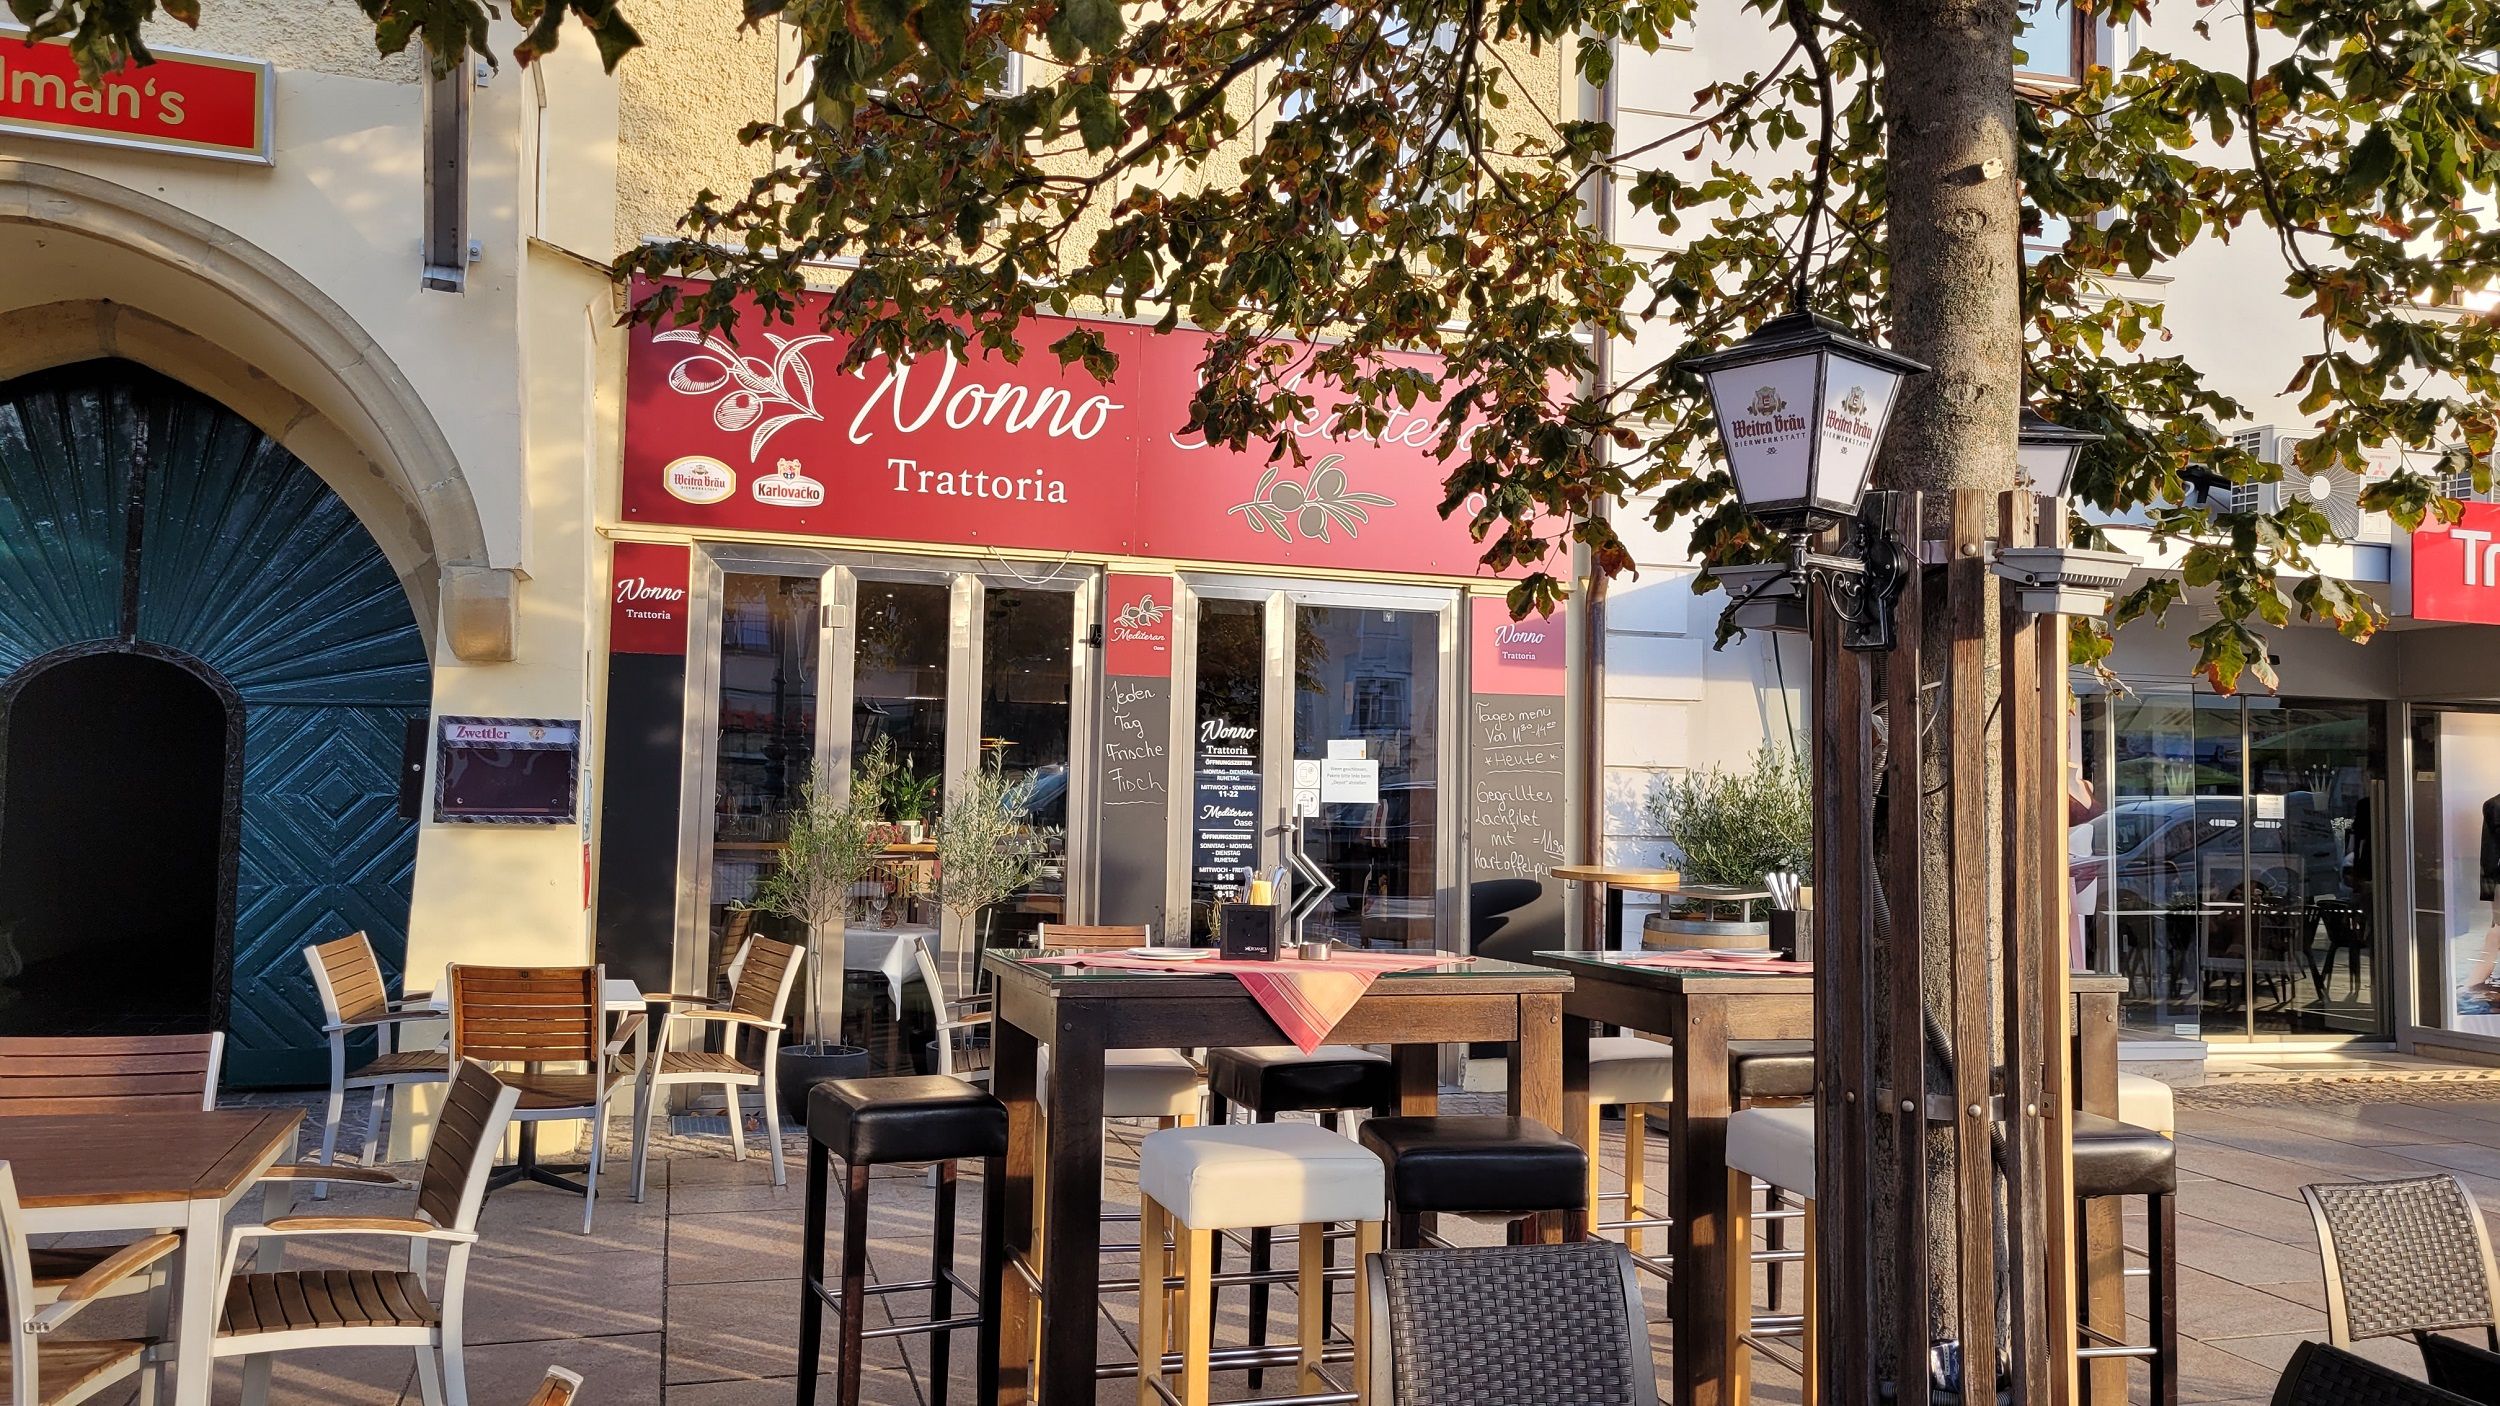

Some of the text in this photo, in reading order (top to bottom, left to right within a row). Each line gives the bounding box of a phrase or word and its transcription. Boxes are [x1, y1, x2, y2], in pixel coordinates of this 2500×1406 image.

[848, 339, 1125, 445] Nonno
[1731, 414, 1806, 440] Weitra Bräu
[1825, 408, 1873, 441] Weitra Bräu
[1734, 432, 1806, 448] BIERWERKSTATT
[1822, 430, 1869, 449] BIERWERKSTATT
[704, 475, 726, 488] Bräu
[887, 458, 1068, 504] Trattoria
[758, 482, 820, 500] Karlovačko
[617, 577, 686, 604] Nonno
[626, 608, 671, 620] Trattoria
[1110, 627, 1166, 642] Mediteran
[1494, 624, 1546, 647] Nonno
[1502, 651, 1536, 660] Trattoria
[1110, 680, 1156, 714] Jeden
[1114, 711, 1145, 739] Tag
[1475, 702, 1515, 731] Tages
[456, 725, 510, 740] Zwettler
[1200, 719, 1257, 743] Nonno
[1484, 727, 1507, 743] Von
[1105, 741, 1165, 763] Frische
[1205, 745, 1249, 755] Trattoria
[1494, 750, 1547, 766] Heute
[1107, 767, 1167, 793] Fisch
[1476, 781, 1553, 811] Gegrilltes
[1200, 805, 1254, 819] Mediteran
[1234, 819, 1253, 827] Oase
[1491, 831, 1516, 847] mit
